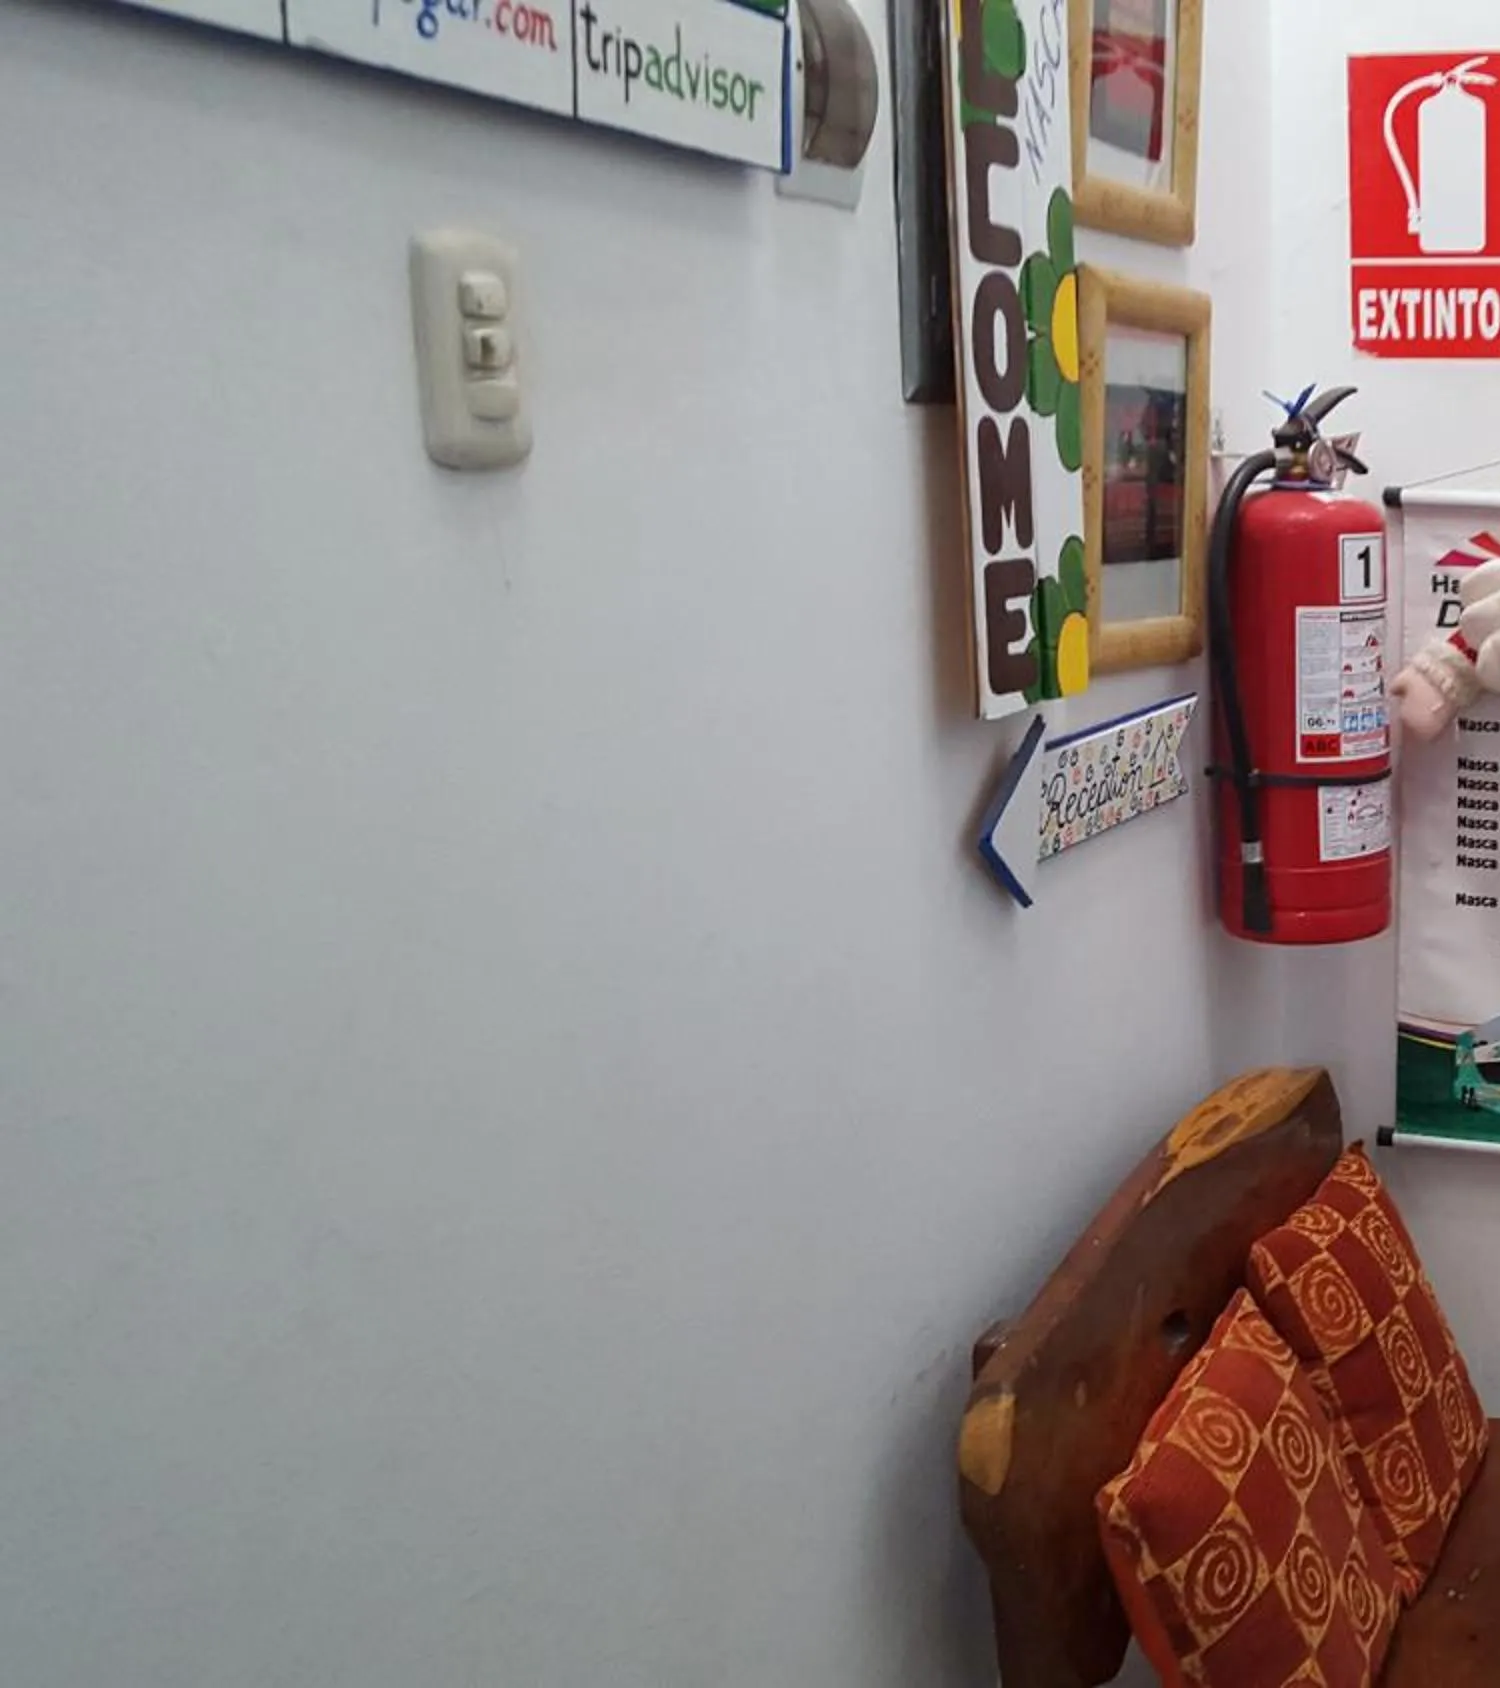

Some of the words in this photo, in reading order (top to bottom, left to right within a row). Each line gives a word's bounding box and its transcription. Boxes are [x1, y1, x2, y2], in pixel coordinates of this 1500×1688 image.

[579, 3, 765, 121] tripadvisor
[1356, 545, 1372, 589] 1
[1457, 717, 1500, 733] Nasca
[1457, 756, 1499, 773] Nasca
[1457, 776, 1499, 793] Nasca
[1457, 796, 1499, 812] Nasca
[1456, 815, 1499, 832] Nasca
[1456, 833, 1499, 851] Nasca
[1455, 853, 1499, 871] Nasca
[1455, 892, 1499, 909] Nasca
